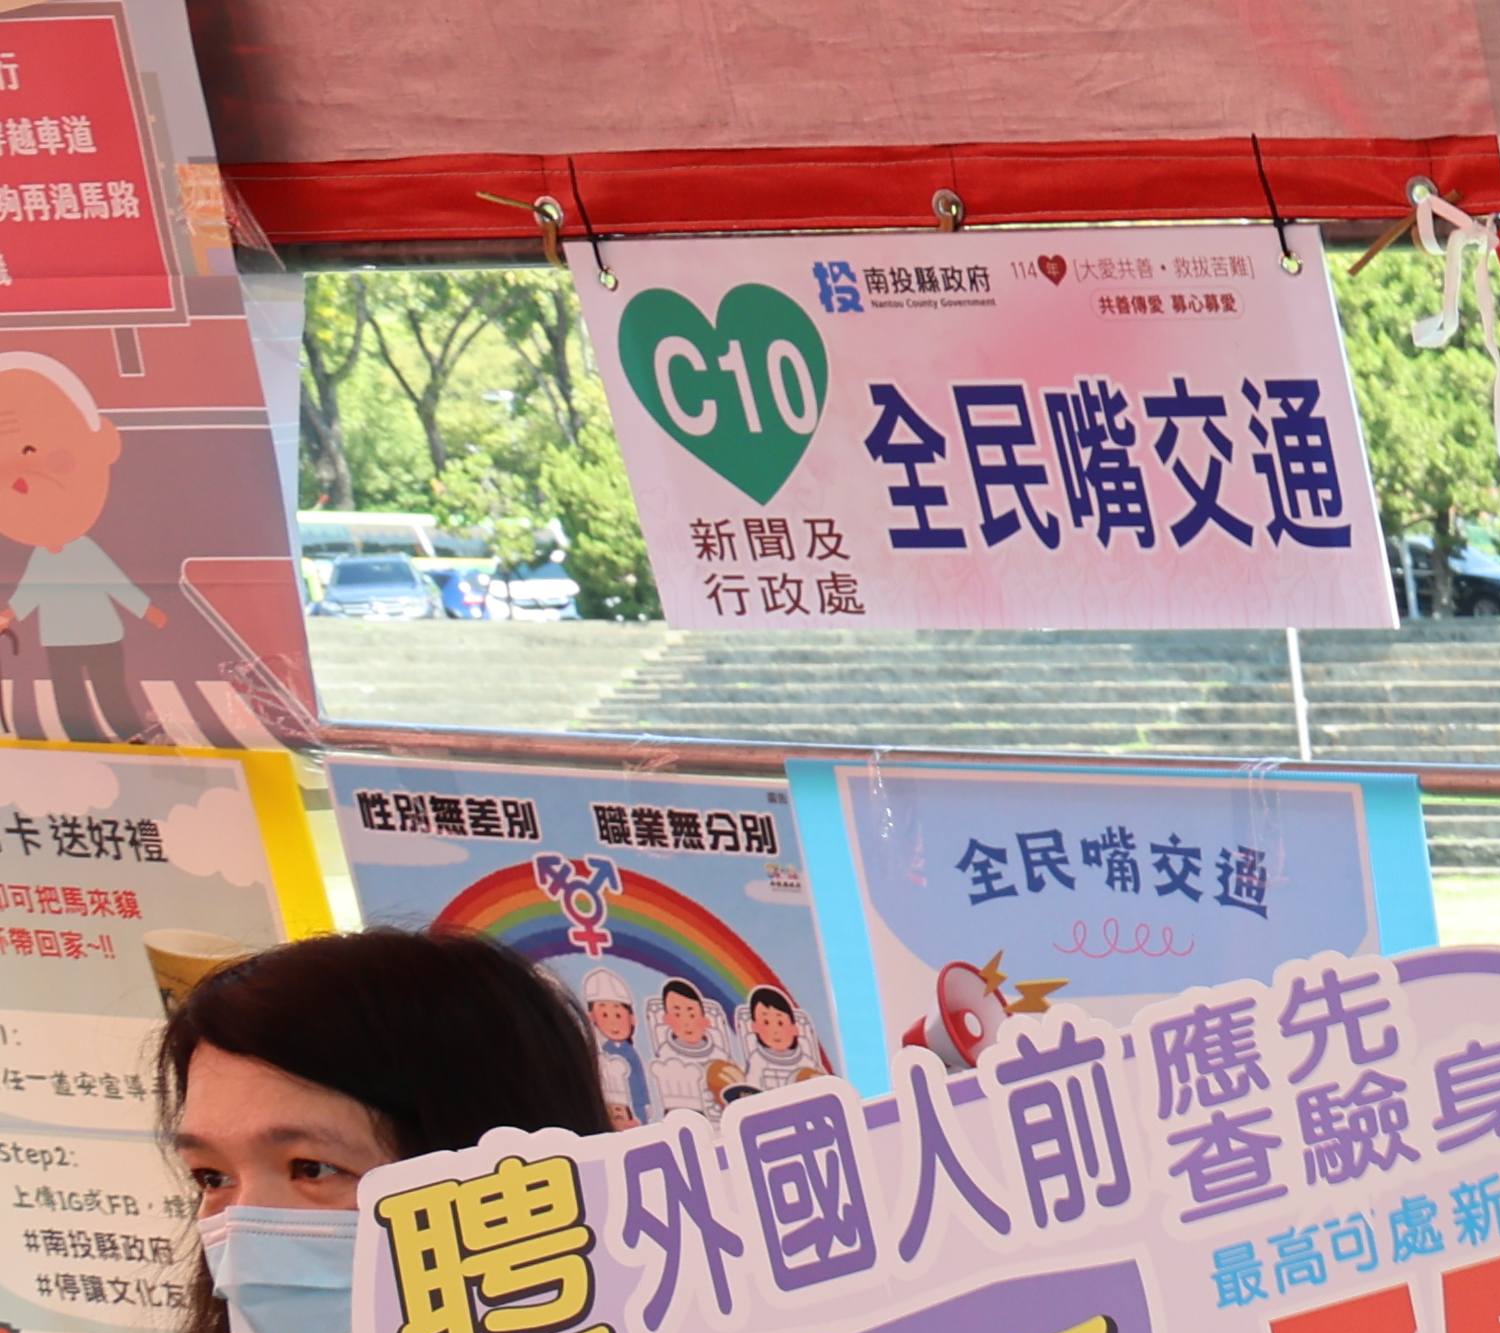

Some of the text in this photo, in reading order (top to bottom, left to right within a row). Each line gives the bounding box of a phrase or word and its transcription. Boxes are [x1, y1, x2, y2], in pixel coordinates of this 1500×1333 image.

[864, 264, 991, 295] 南投縣政府
[871, 296, 996, 309] Nantou County Government
[655, 335, 819, 437] C10
[864, 374, 1352, 550] 全民嘴交通
[691, 517, 851, 565] 新聞及
[704, 570, 868, 617] 行政處
[355, 790, 778, 854] 性別無差別 職業無分別
[955, 826, 1269, 919] 全民嘴交通
[1150, 968, 1400, 1121] 應先
[622, 1020, 1132, 1333] 外國人前
